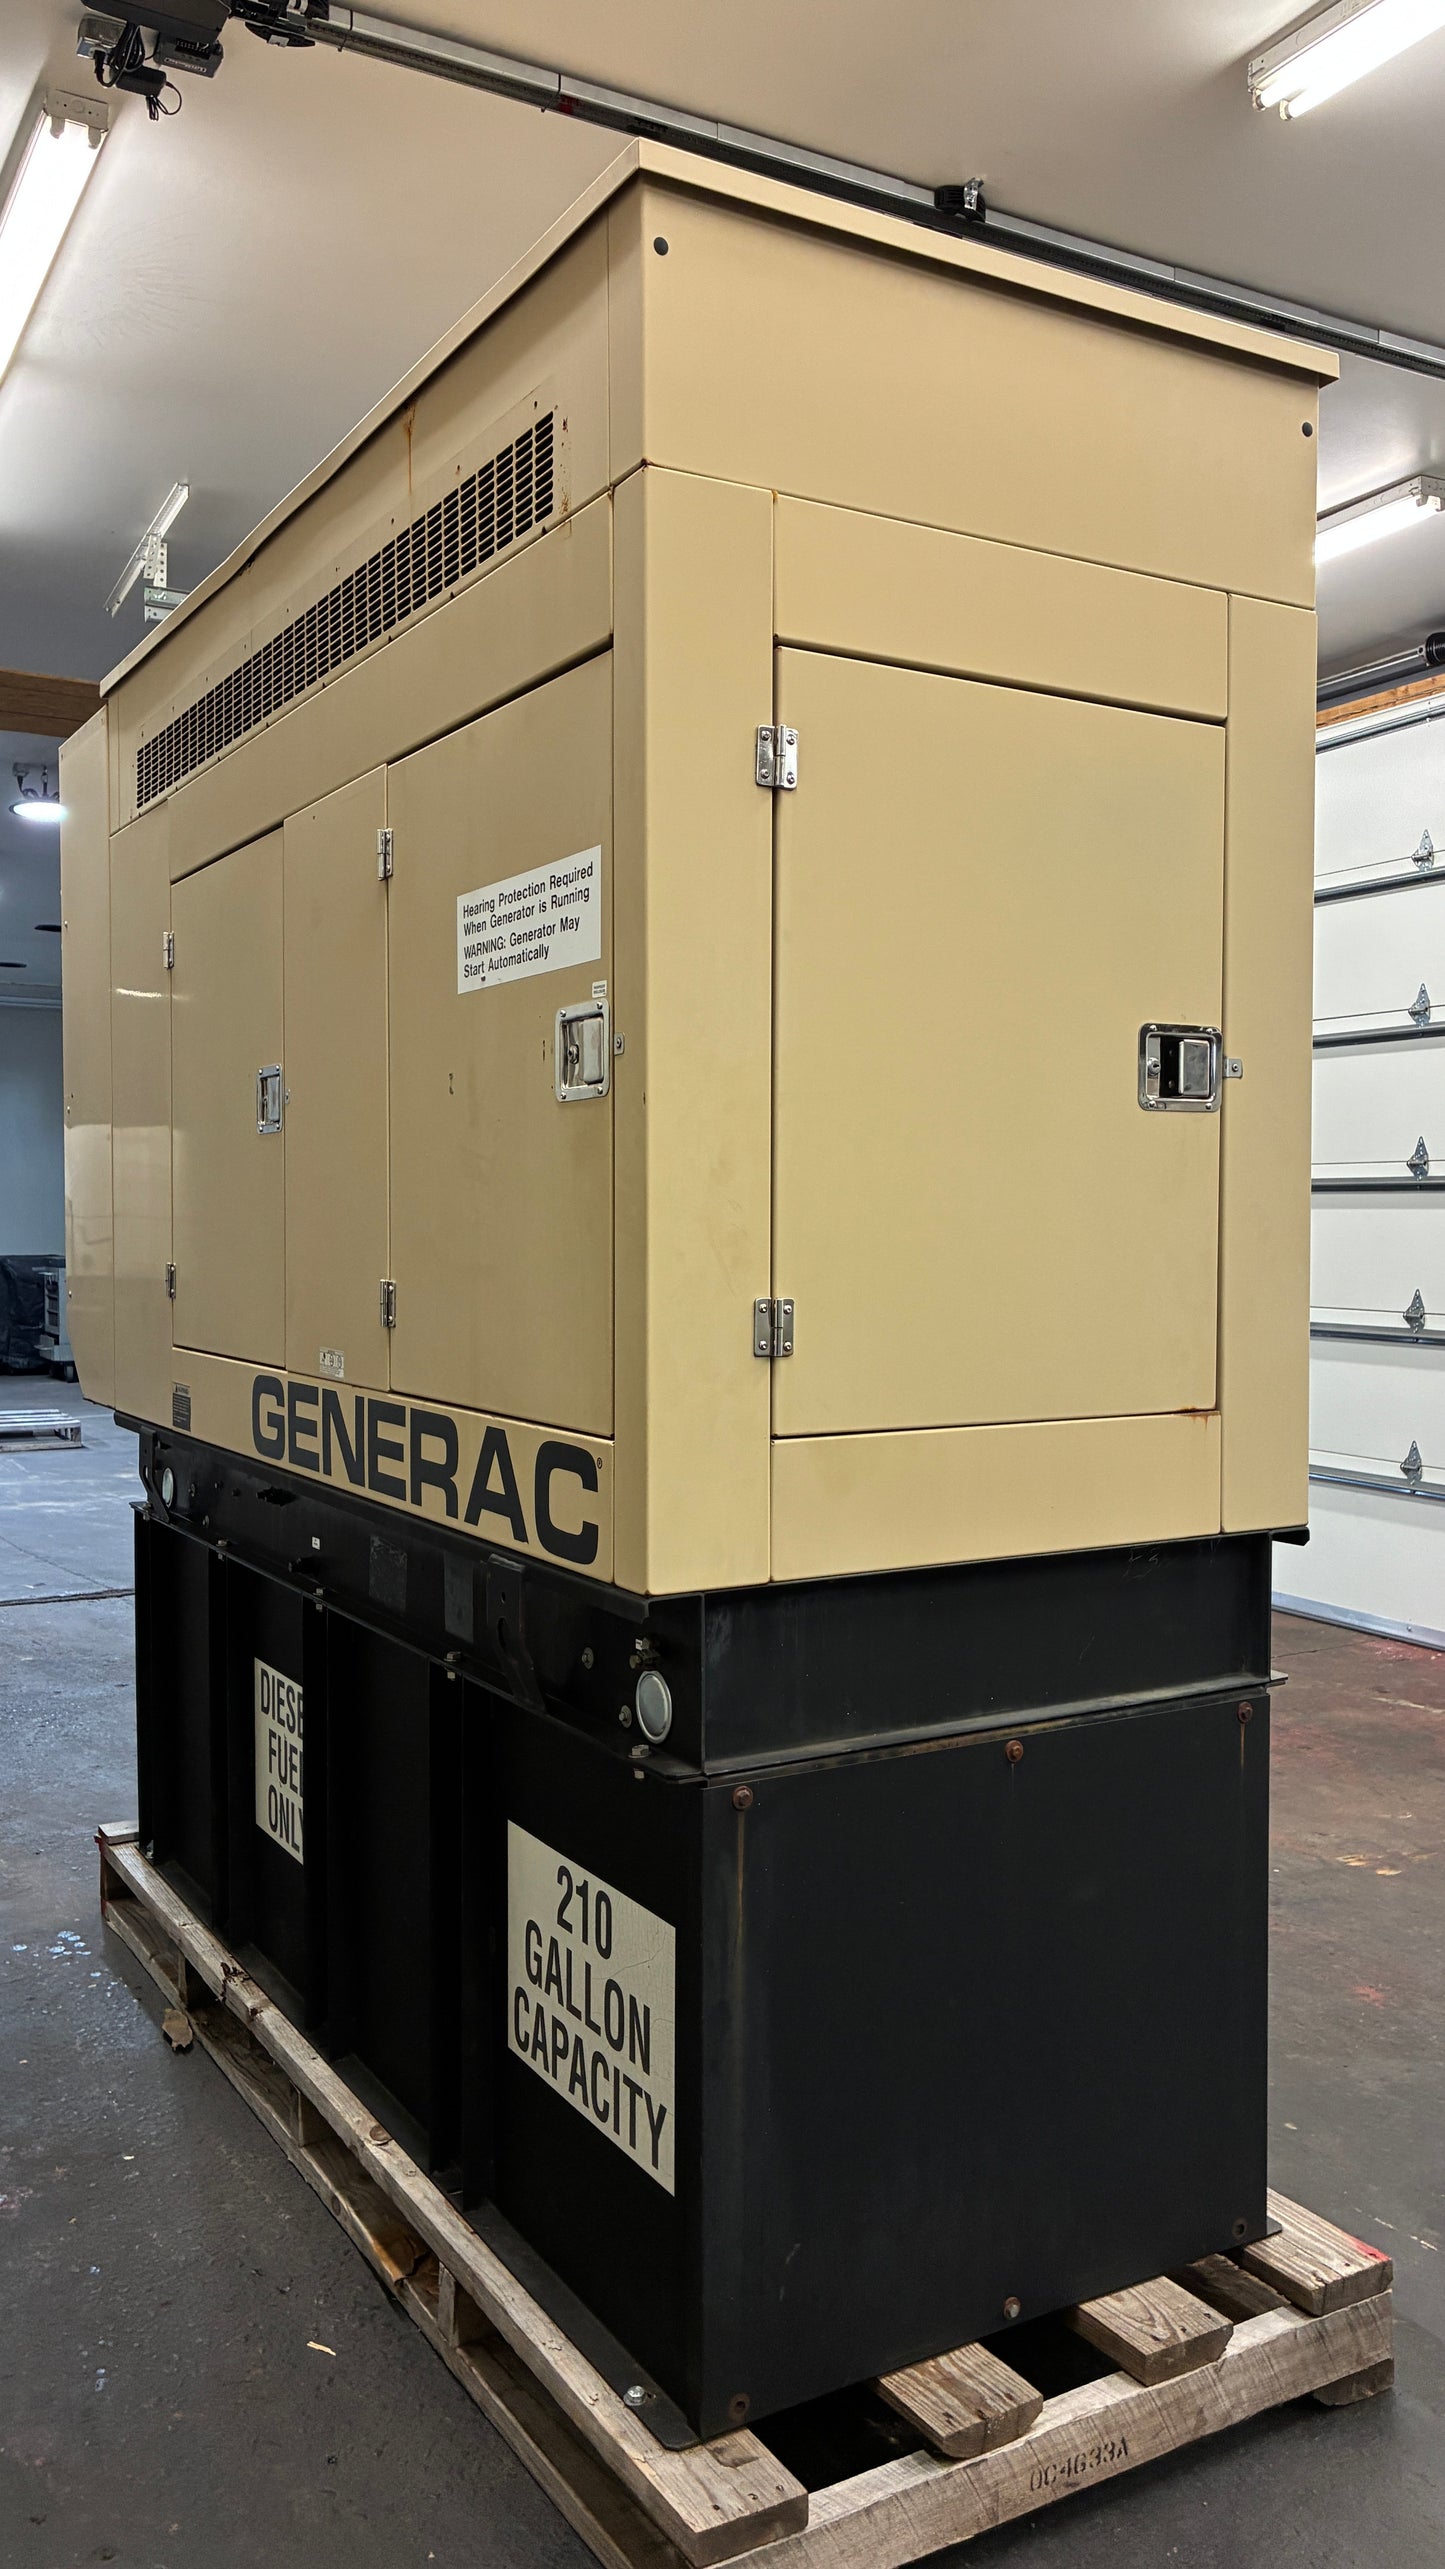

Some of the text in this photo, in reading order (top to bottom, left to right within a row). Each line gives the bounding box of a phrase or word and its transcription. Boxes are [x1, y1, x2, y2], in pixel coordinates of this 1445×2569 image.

[463, 861, 593, 919] Hearing Protection Required
[463, 887, 590, 936] When Generator is Running
[463, 916, 580, 960] WARNING: Generator May
[463, 943, 550, 978] Start Automatically
[252, 1374, 599, 1566] GENERAC
[556, 1865, 612, 1960] 210
[525, 1919, 651, 2077] GALLON
[514, 1986, 667, 2170] CAPACITY
